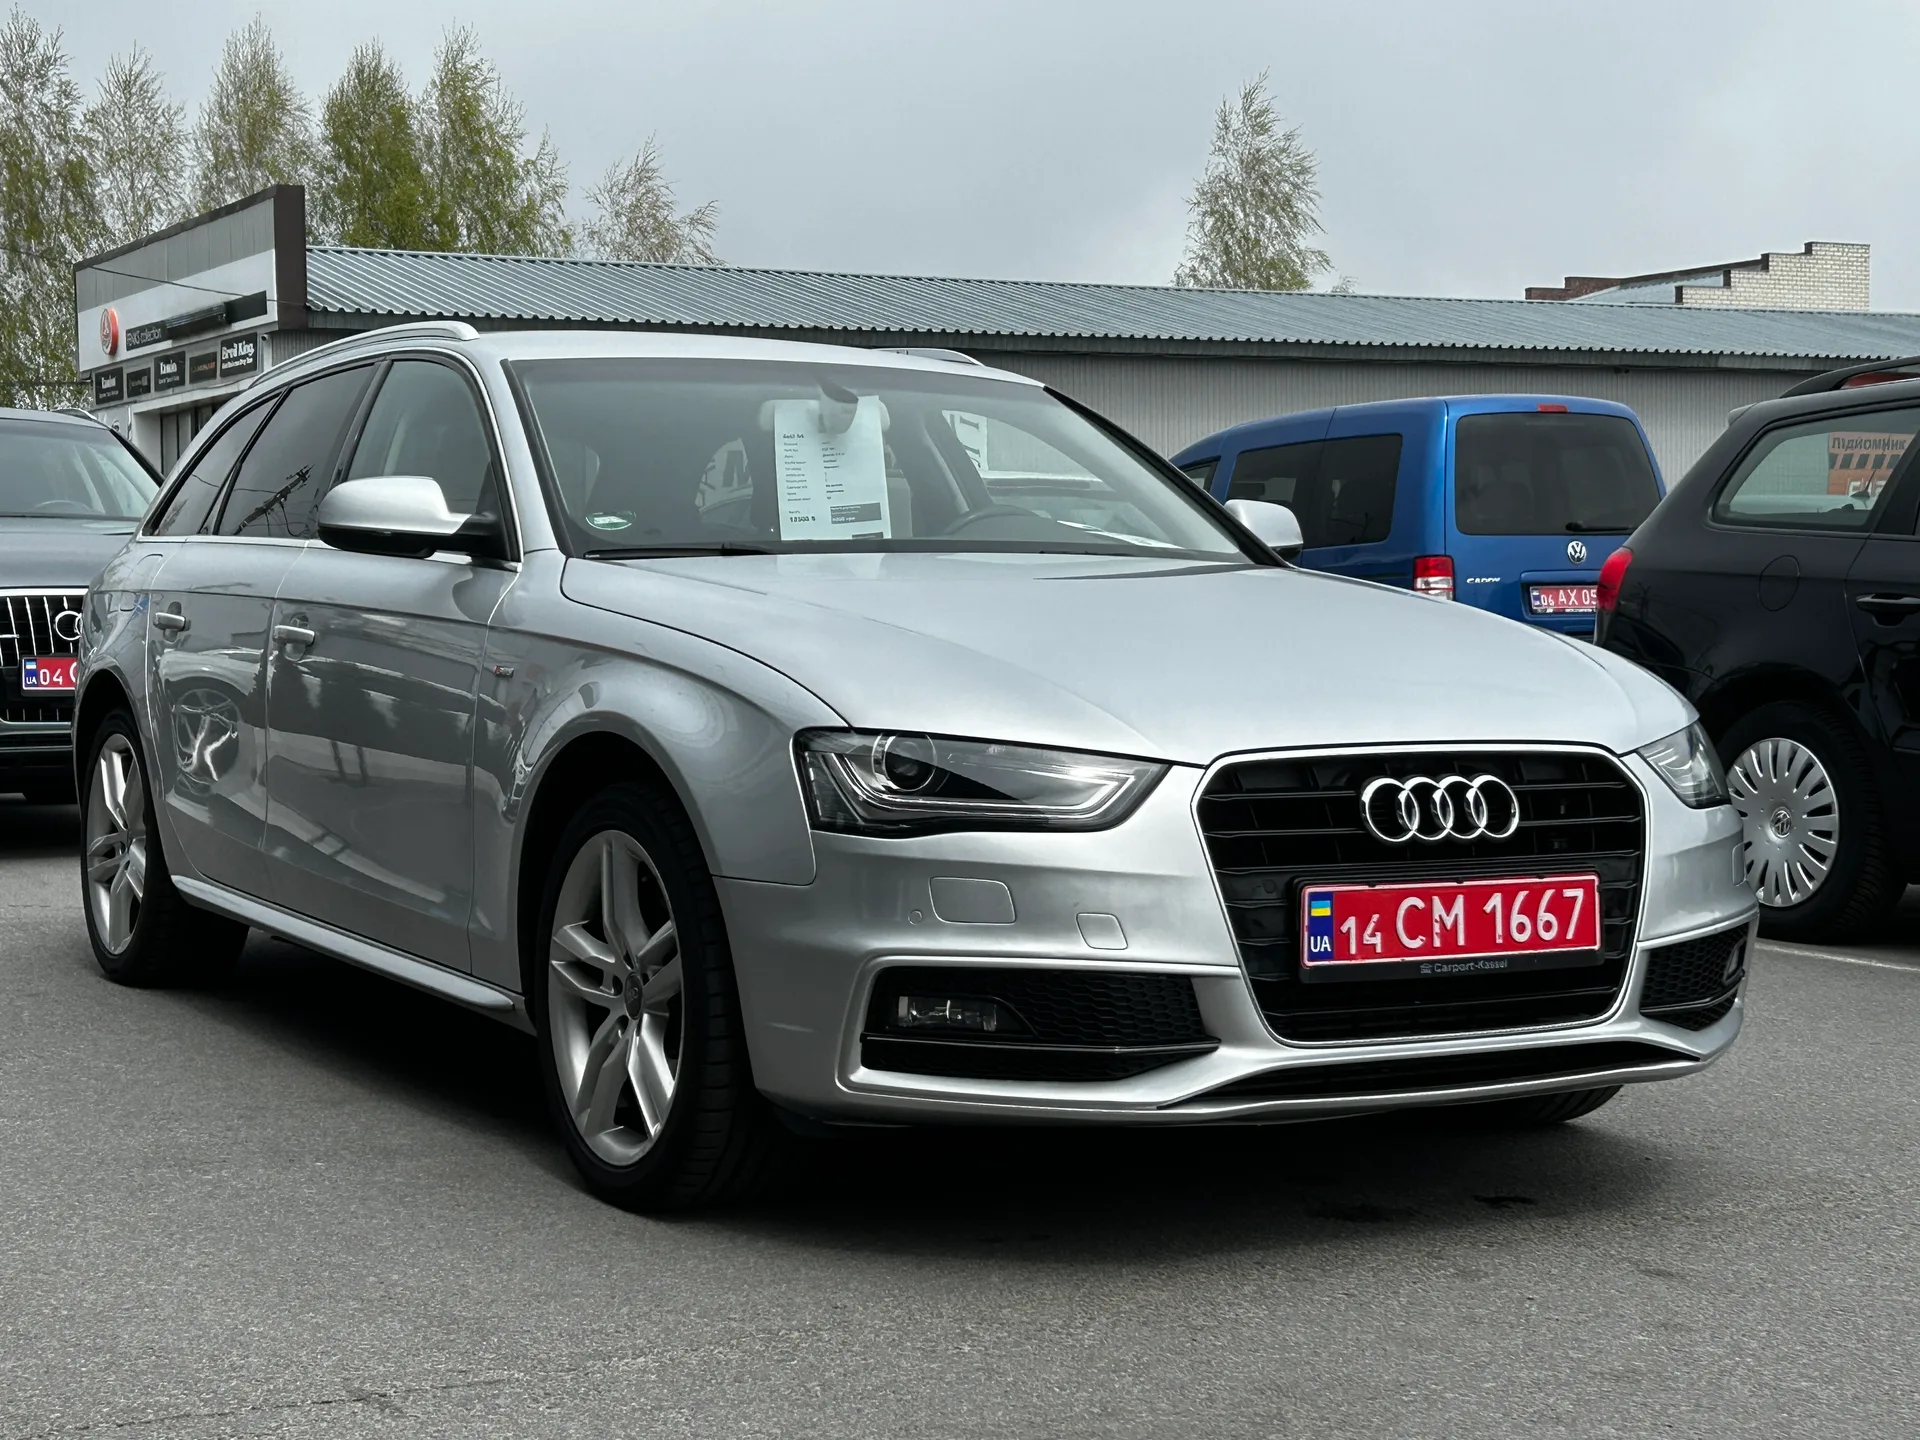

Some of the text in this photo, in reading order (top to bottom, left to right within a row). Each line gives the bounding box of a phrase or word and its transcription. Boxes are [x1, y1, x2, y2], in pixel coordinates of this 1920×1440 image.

[1541, 594, 1555, 606] 06
[1558, 589, 1579, 606] AX
[26, 676, 37, 685] UA
[40, 668, 63, 685] 04
[1340, 888, 1584, 955] 14 CM 1667
[1310, 935, 1332, 953] UA
[1434, 959, 1508, 973] Carport-Kassel
